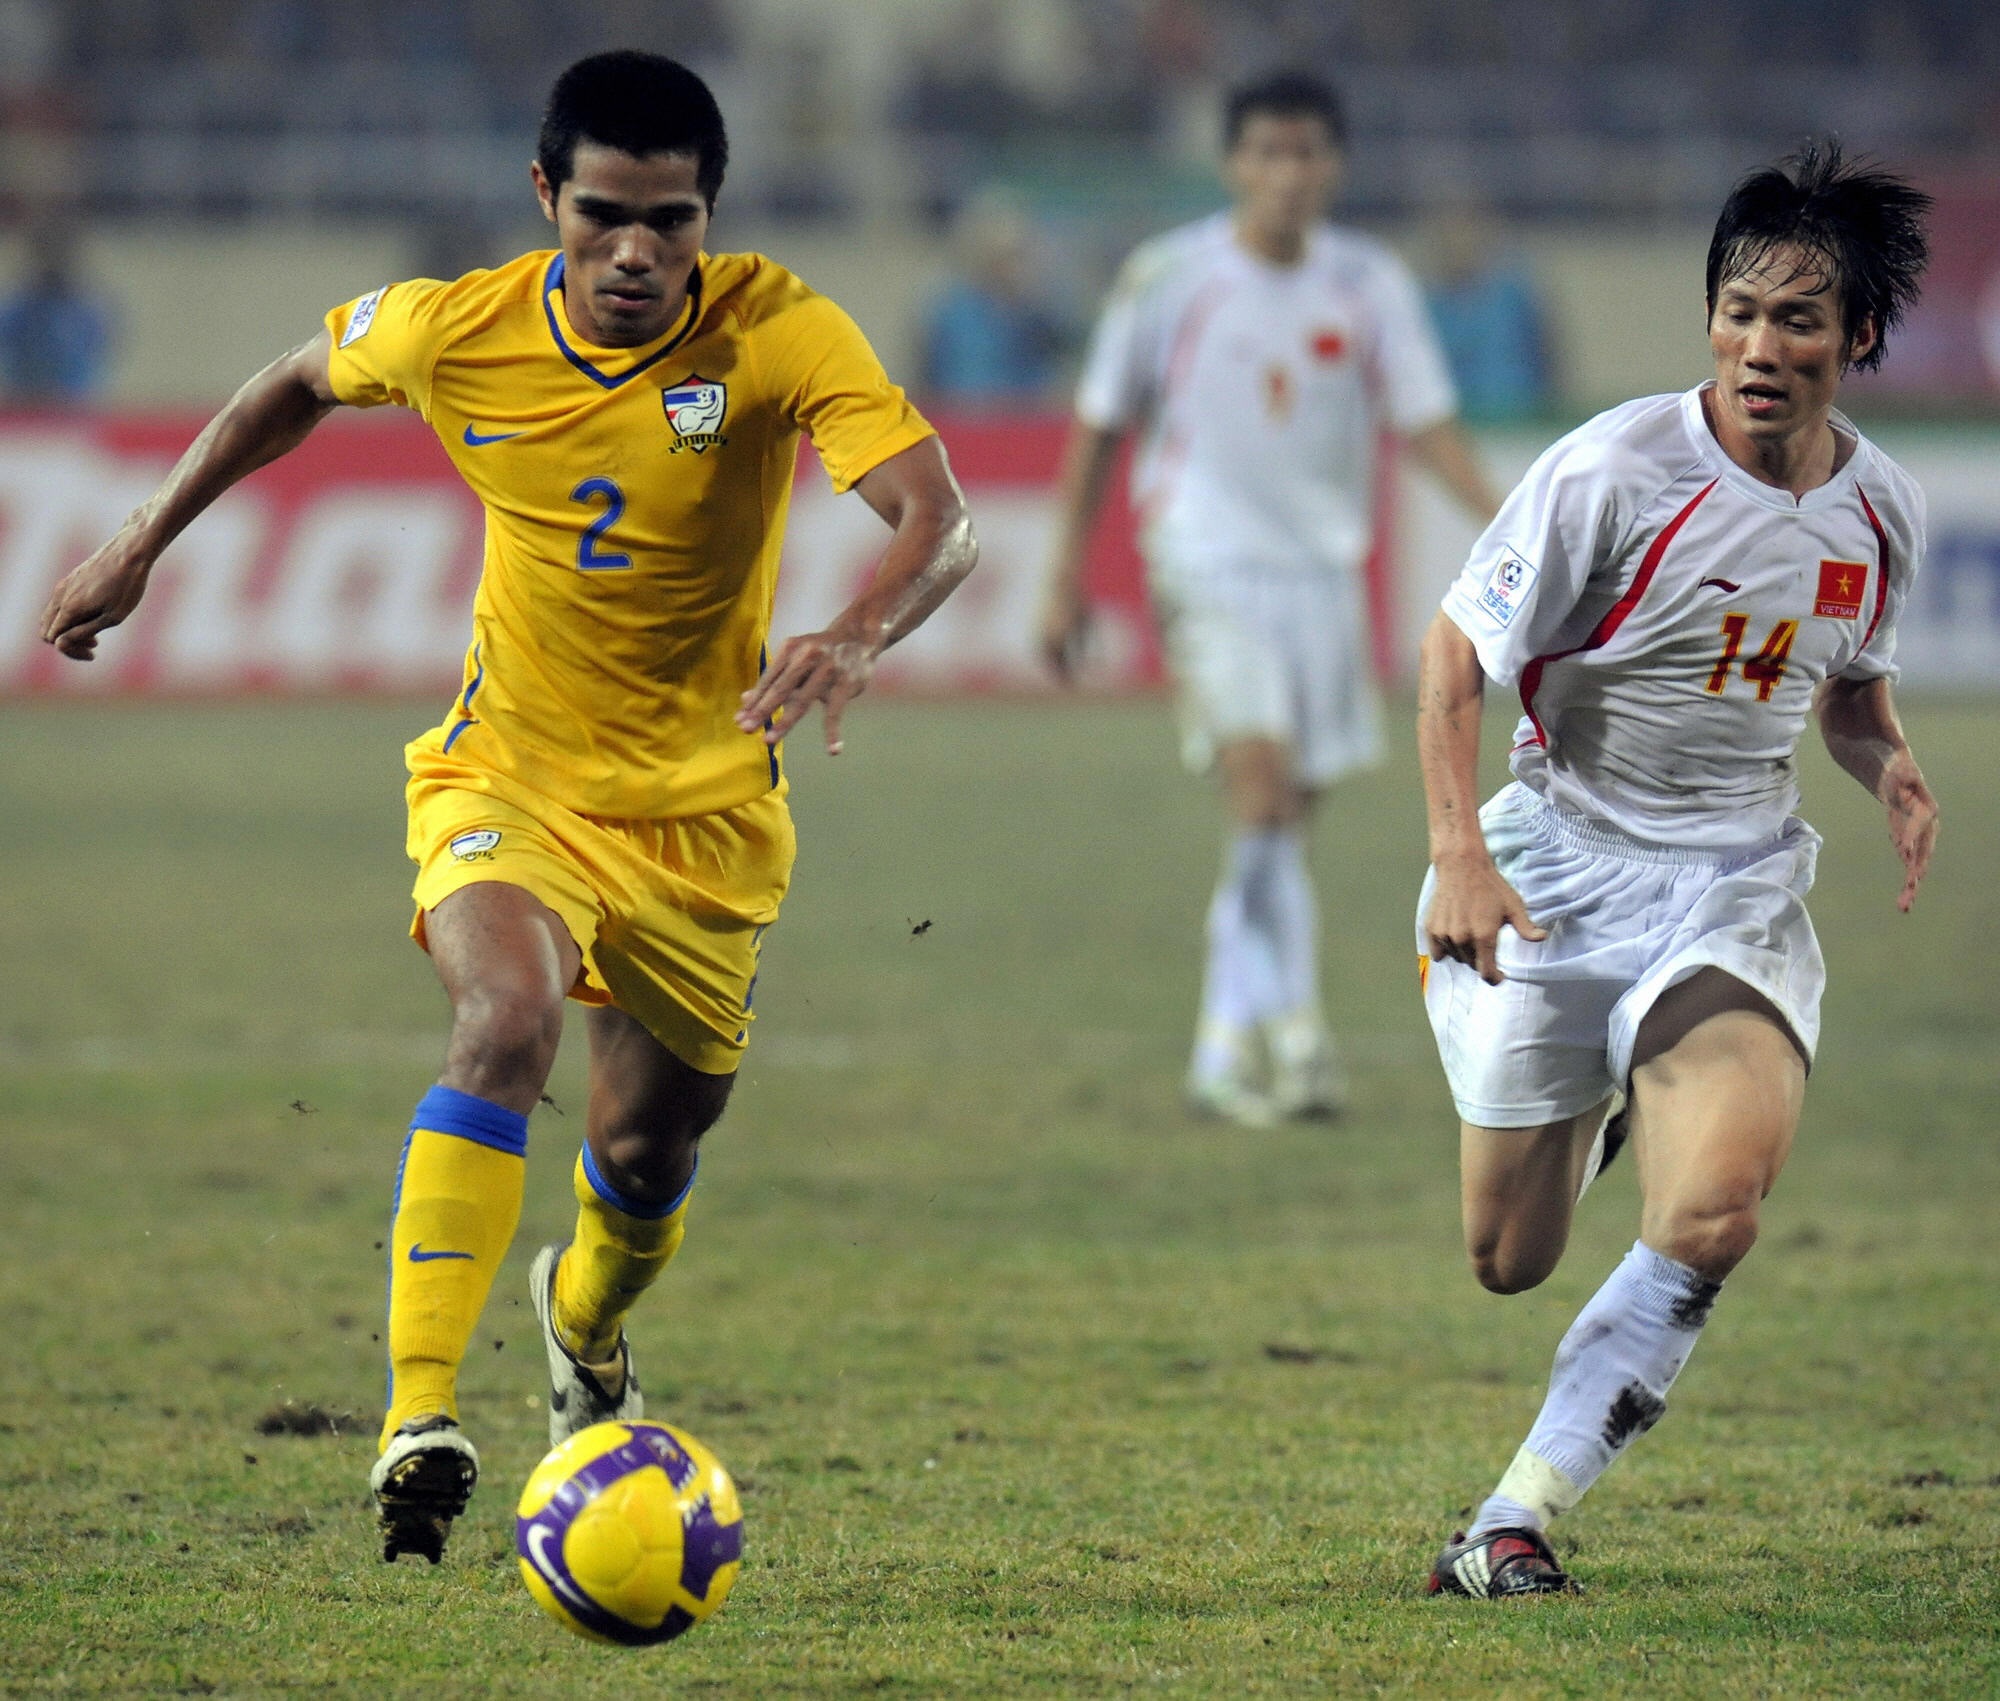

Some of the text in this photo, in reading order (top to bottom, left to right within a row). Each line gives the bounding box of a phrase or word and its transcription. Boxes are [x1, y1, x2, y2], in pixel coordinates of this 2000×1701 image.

[568, 476, 634, 571] 2
[1820, 604, 1857, 616] VIETNAM
[1704, 611, 1799, 703] 14
